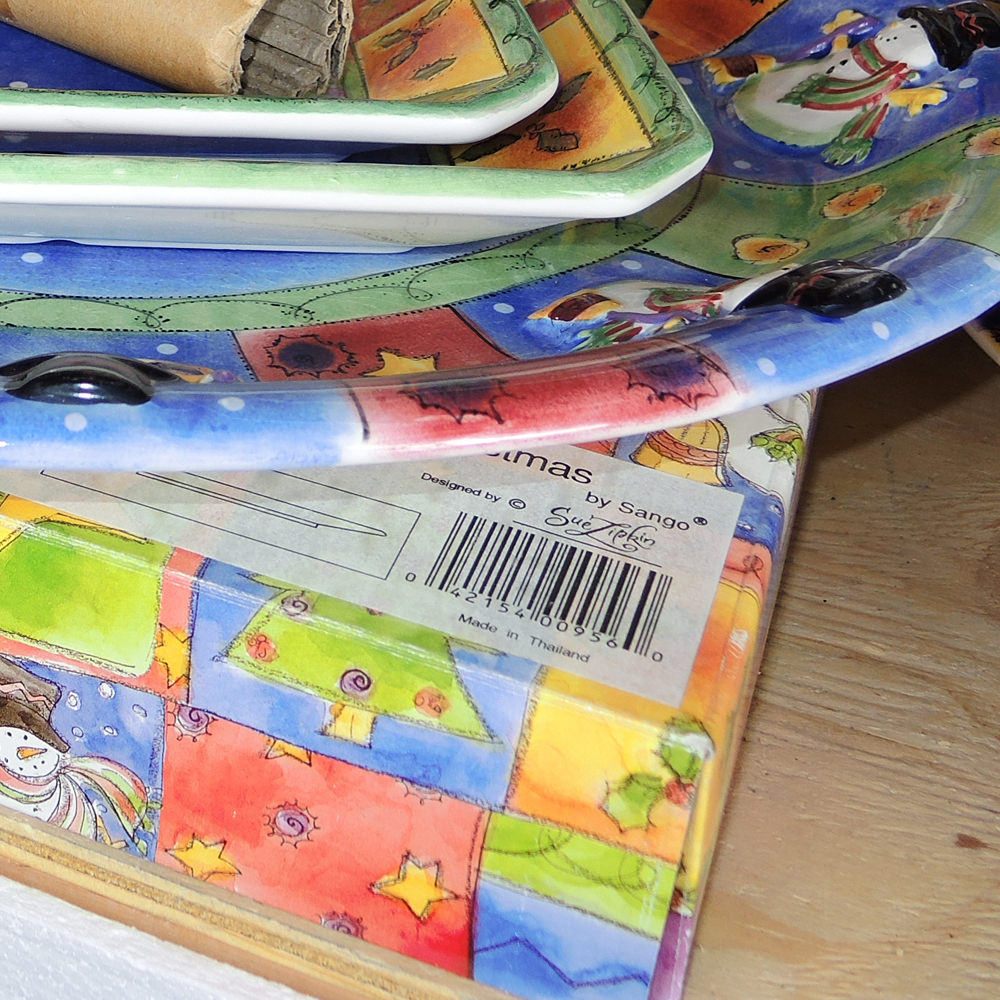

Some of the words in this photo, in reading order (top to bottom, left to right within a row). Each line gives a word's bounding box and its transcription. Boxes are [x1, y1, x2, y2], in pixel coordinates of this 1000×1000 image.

[485, 450, 593, 485] tmas
[421, 472, 482, 497] Designed
[484, 491, 502, 503] by
[585, 491, 612, 509] by
[405, 572, 417, 583] 0
[450, 587, 525, 619] 42154
[540, 615, 618, 649] 00956
[651, 651, 664, 663] 0
[458, 613, 498, 633] Made
[506, 628, 519, 641] in
[530, 635, 591, 663] Thailand
